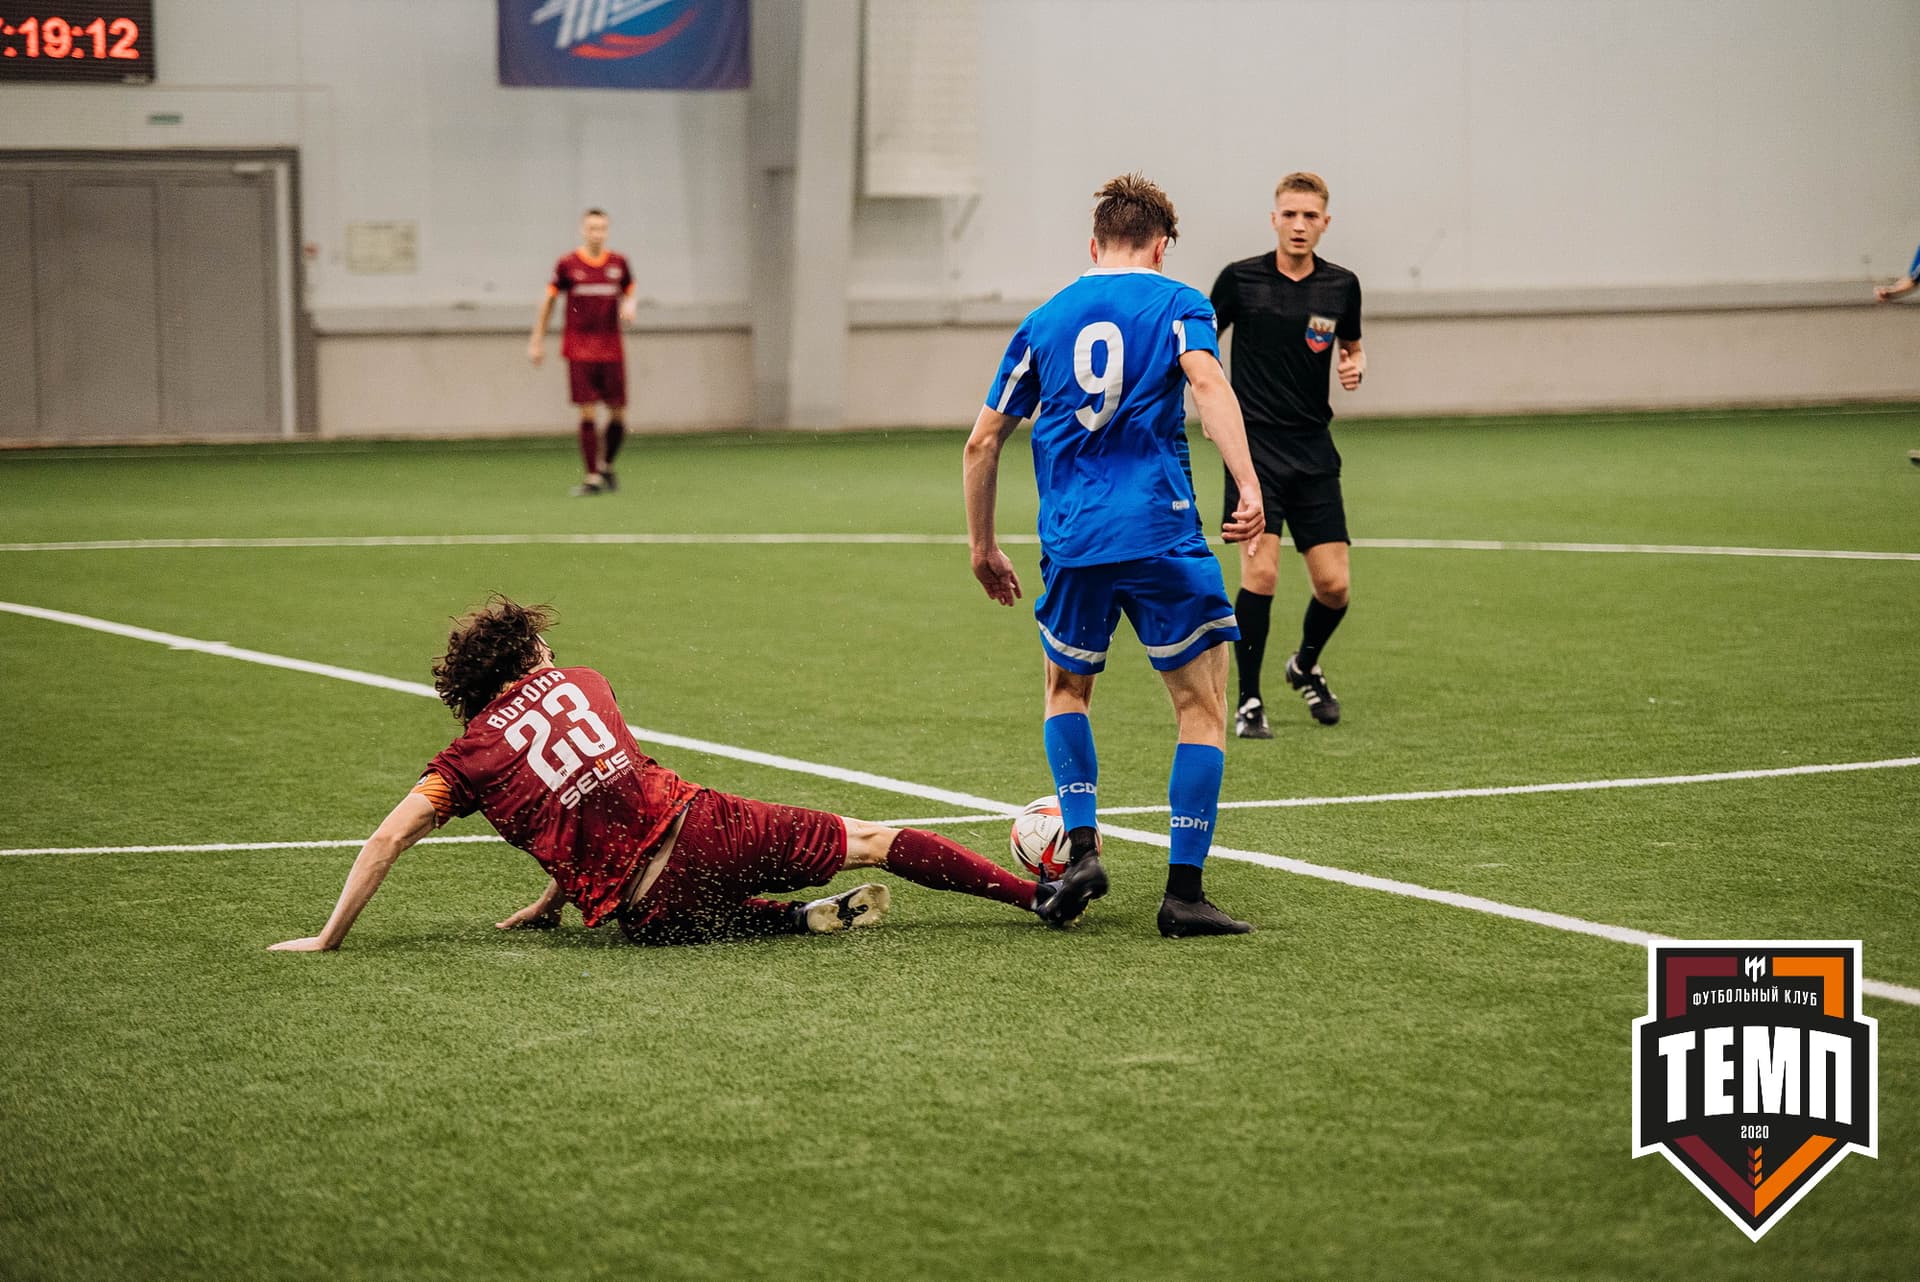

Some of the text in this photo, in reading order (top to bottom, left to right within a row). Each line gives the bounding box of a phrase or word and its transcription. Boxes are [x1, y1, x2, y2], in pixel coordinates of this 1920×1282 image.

[0, 16, 139, 59] :19:12
[1073, 321, 1124, 432] 9
[503, 682, 617, 792] 23
[559, 749, 632, 810] SEUS
[1058, 782, 1096, 798] FCD
